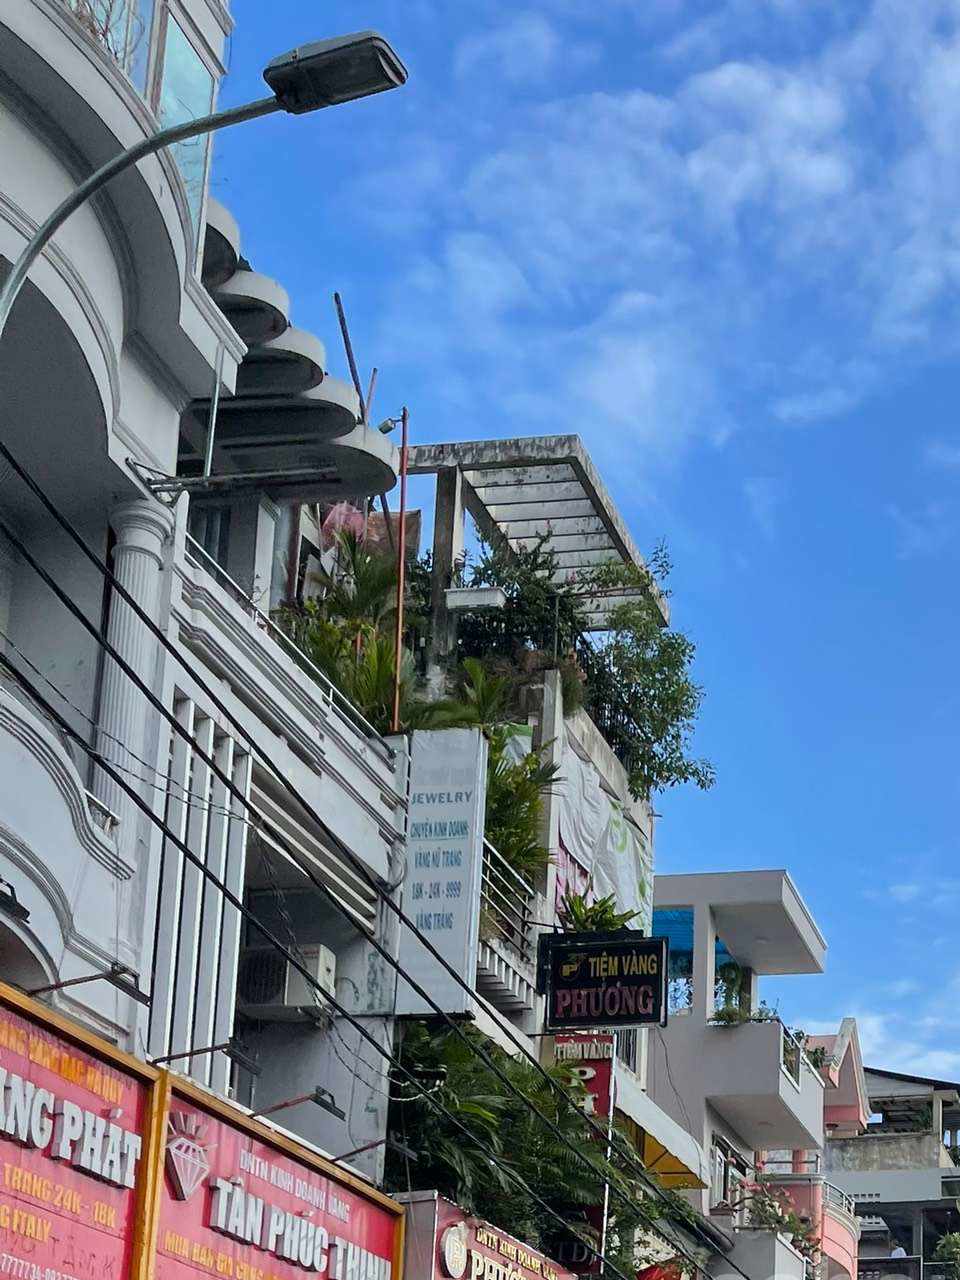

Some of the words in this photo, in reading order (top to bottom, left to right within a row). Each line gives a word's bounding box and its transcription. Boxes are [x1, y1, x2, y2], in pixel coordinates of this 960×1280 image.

[412, 790, 472, 804] JEWELRY
[622, 950, 658, 976] VÀNG
[59, 1108, 142, 1189] PHÁT
[215, 1176, 264, 1246] TÂN
[268, 1211, 329, 1273] PHÚC
